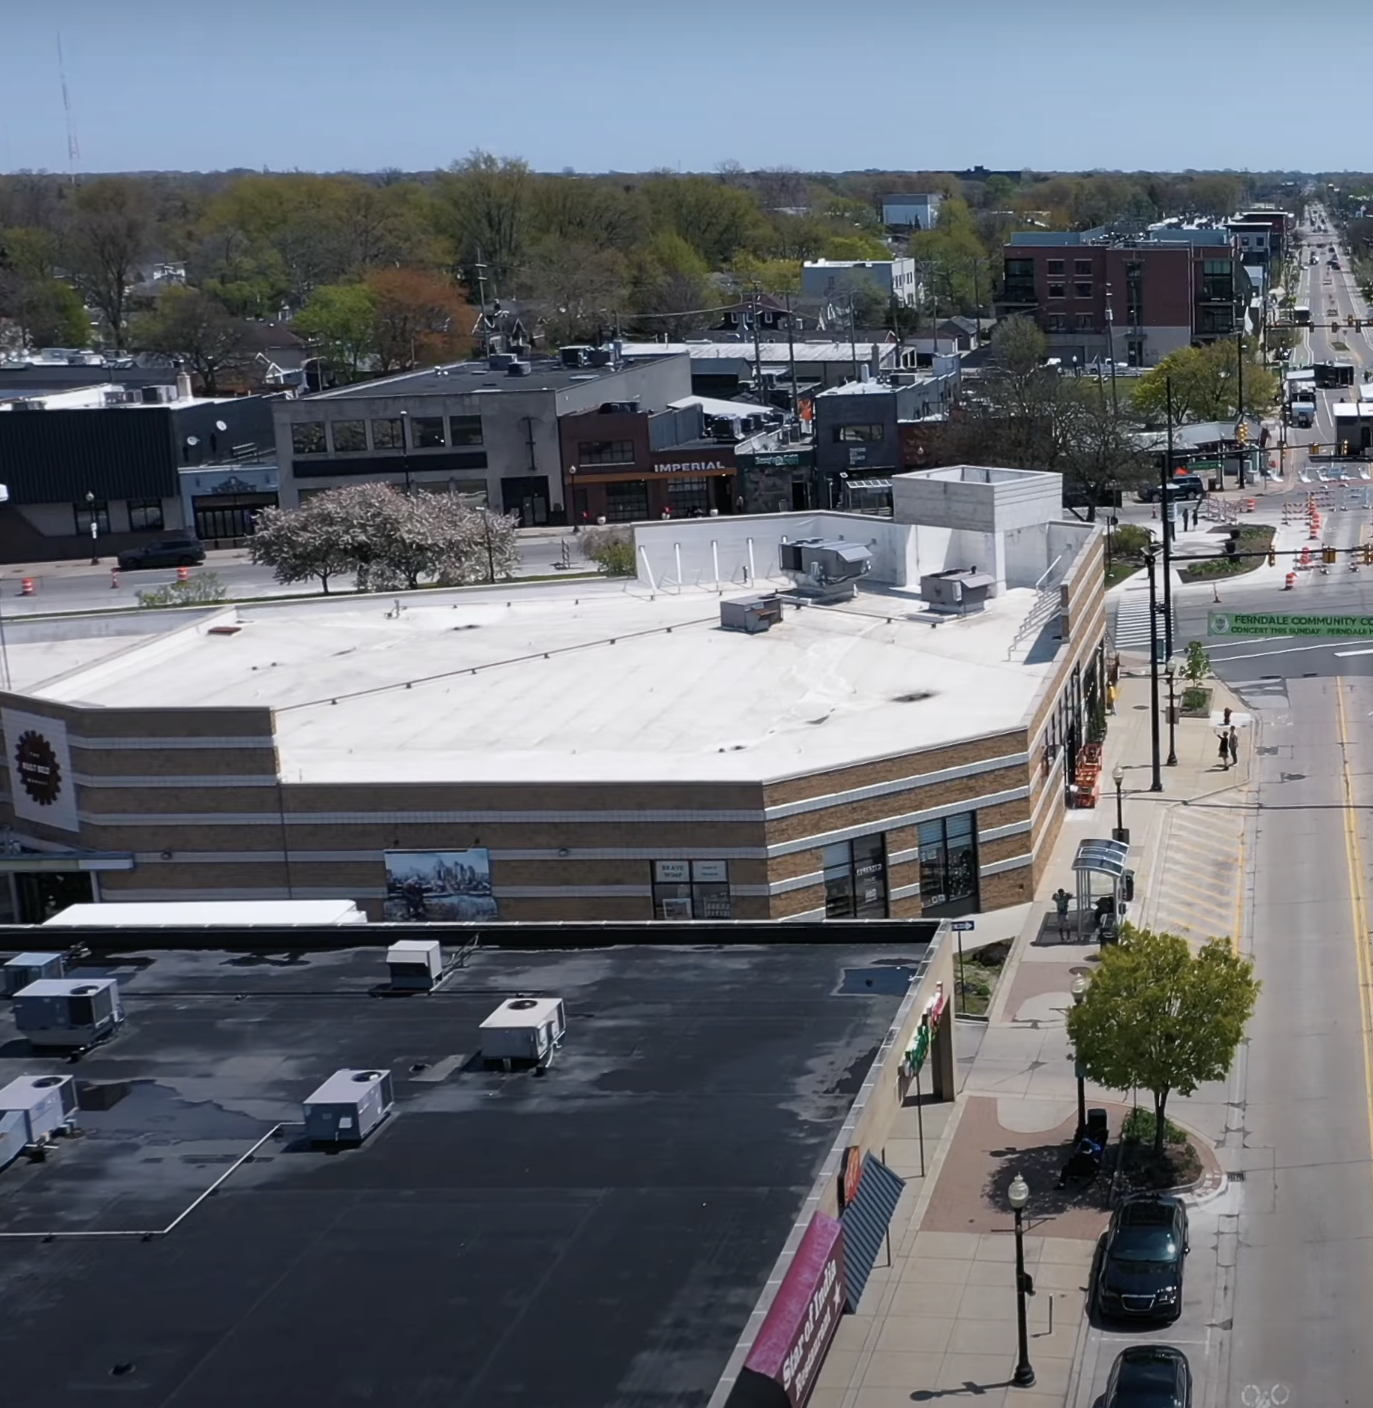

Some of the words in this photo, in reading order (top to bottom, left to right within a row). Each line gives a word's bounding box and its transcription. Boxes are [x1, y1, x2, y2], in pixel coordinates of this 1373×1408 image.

[654, 461, 725, 472] IMPERIAL
[1235, 615, 1289, 625] FERNDALE
[1290, 617, 1357, 626] COMMUNITY
[1231, 626, 1268, 634] CONCERT
[1289, 627, 1320, 635] SUNDAY
[783, 1334, 804, 1391] Star
[803, 1302, 815, 1342] of
[814, 1259, 837, 1320] India
[795, 1305, 830, 1402] Restaurant
